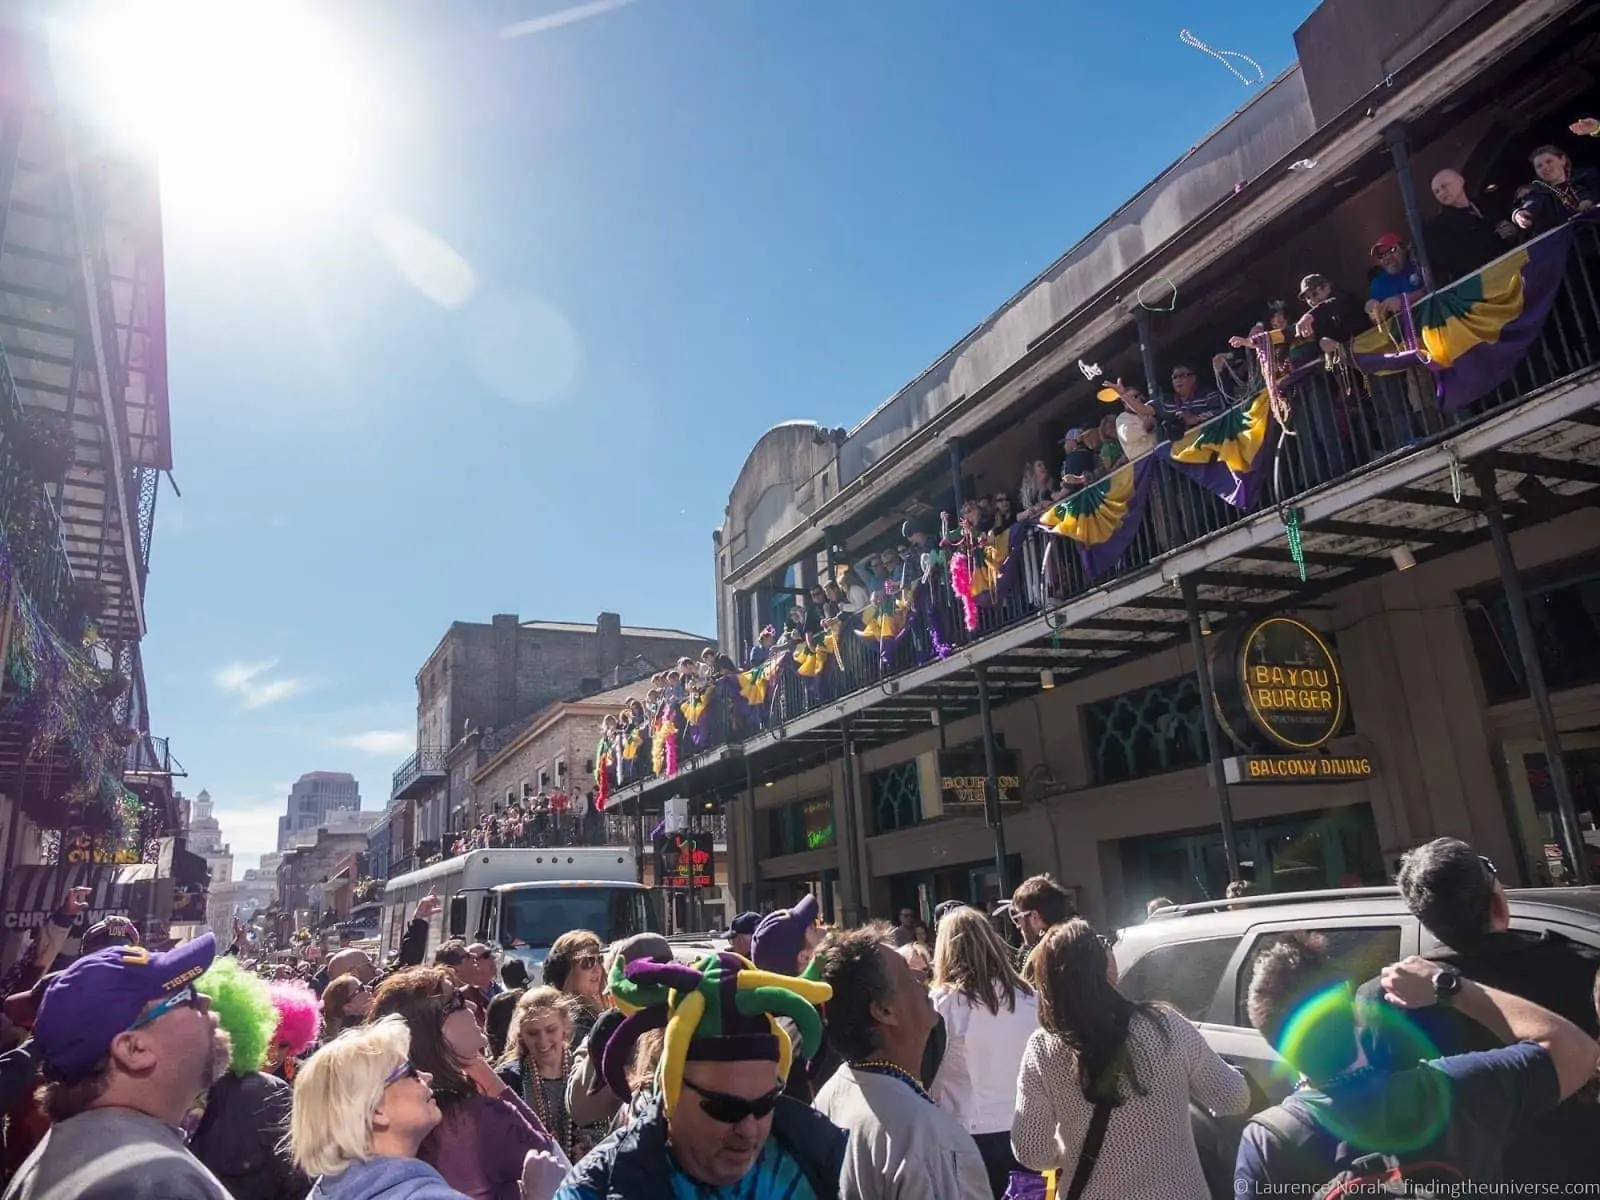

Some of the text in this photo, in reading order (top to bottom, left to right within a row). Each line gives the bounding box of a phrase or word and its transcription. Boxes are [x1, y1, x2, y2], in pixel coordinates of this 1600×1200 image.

[1255, 665, 1329, 687] BAYOU
[1258, 689, 1332, 709] BURGER
[1250, 758, 1371, 777] BALCONY DINING
[942, 775, 1019, 790] BOURON
[161, 965, 204, 991] TIGERS
